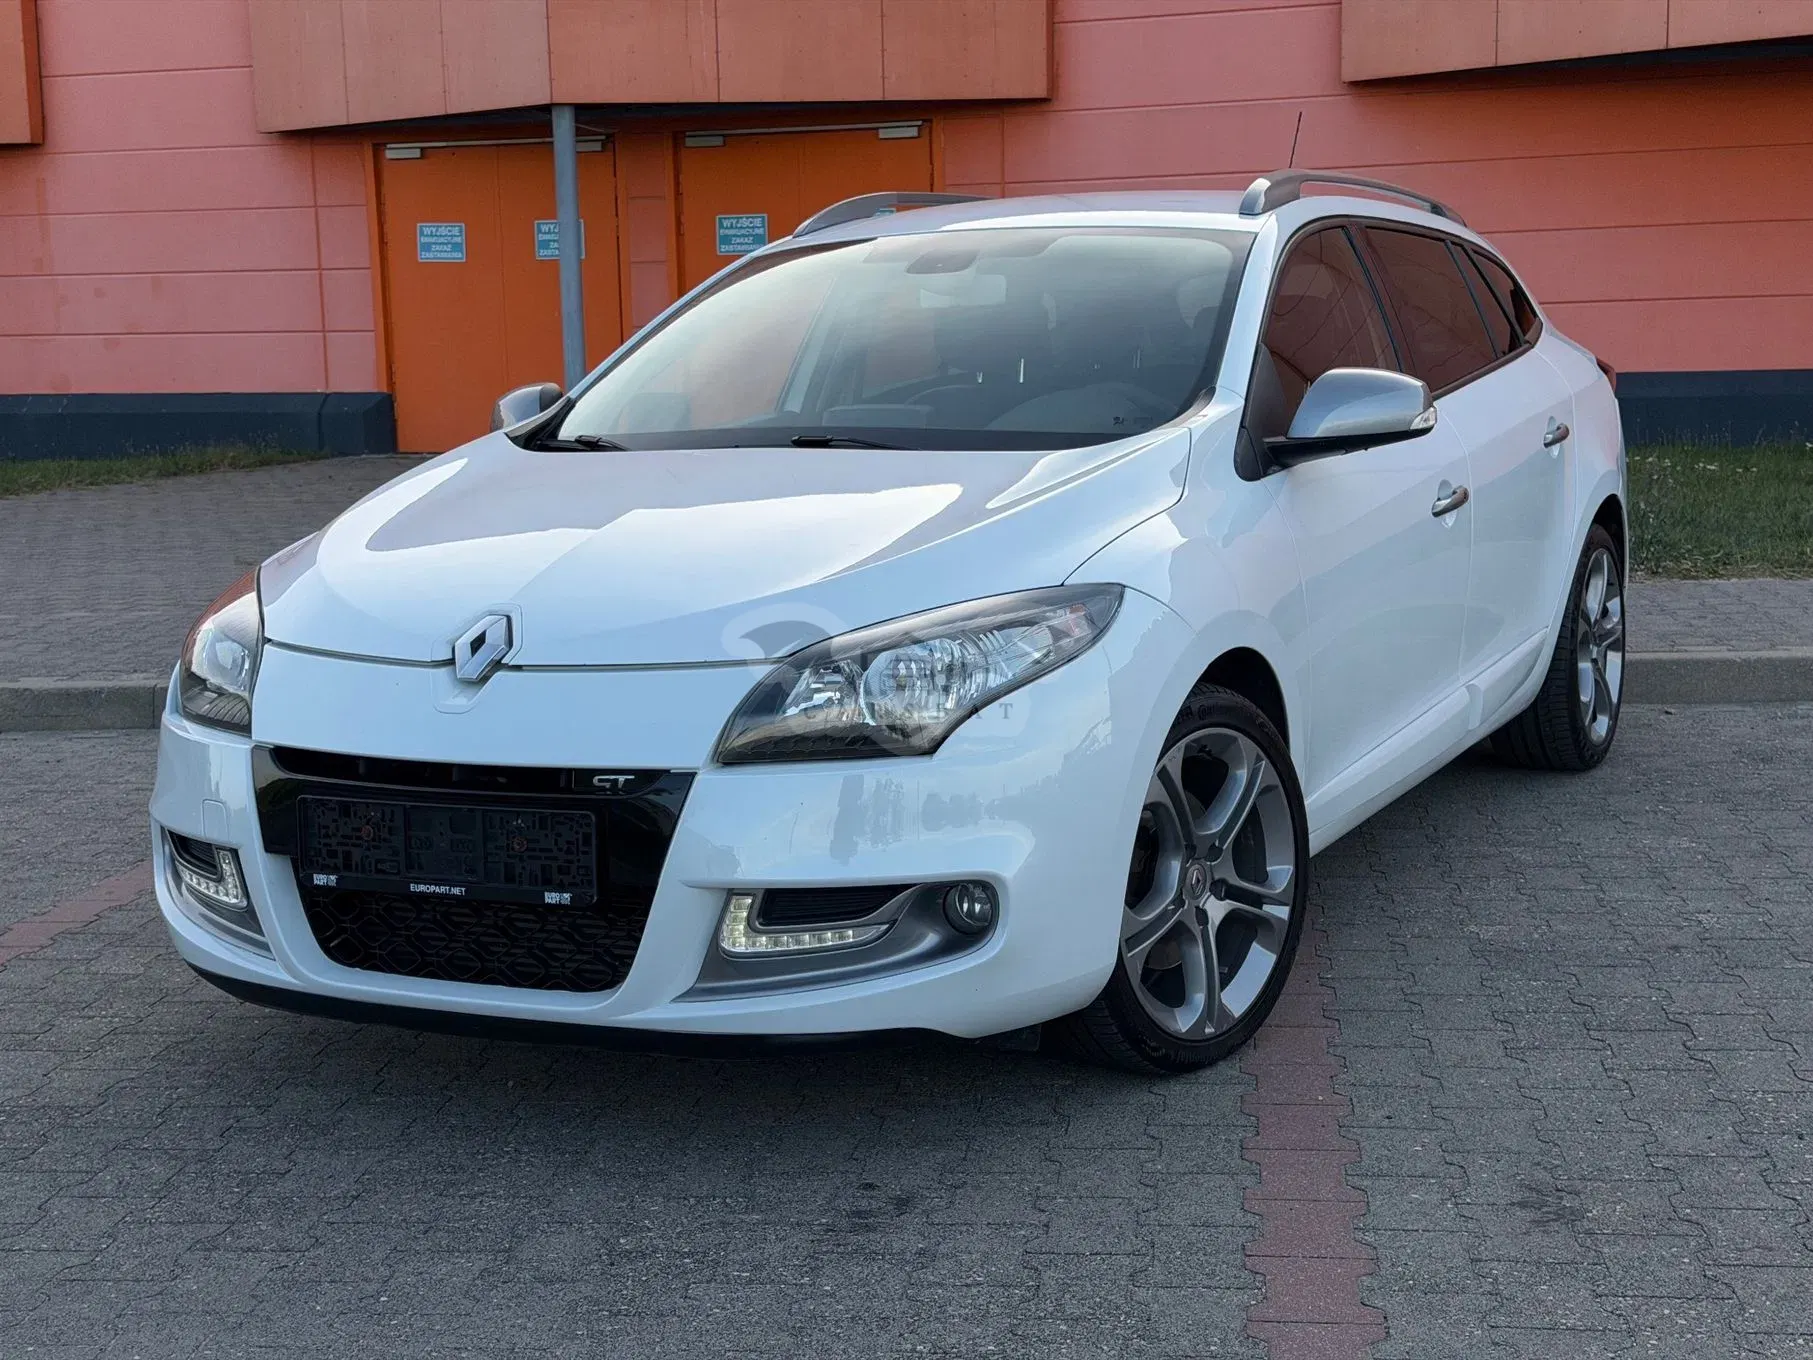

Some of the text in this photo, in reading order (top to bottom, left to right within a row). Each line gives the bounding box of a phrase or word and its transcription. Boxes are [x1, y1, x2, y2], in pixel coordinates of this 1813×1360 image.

[721, 217, 762, 228] WYJŚCIE
[423, 226, 461, 236] WYJŚCIE
[592, 775, 635, 788] GT
[410, 883, 466, 896] EUROPART.NET
